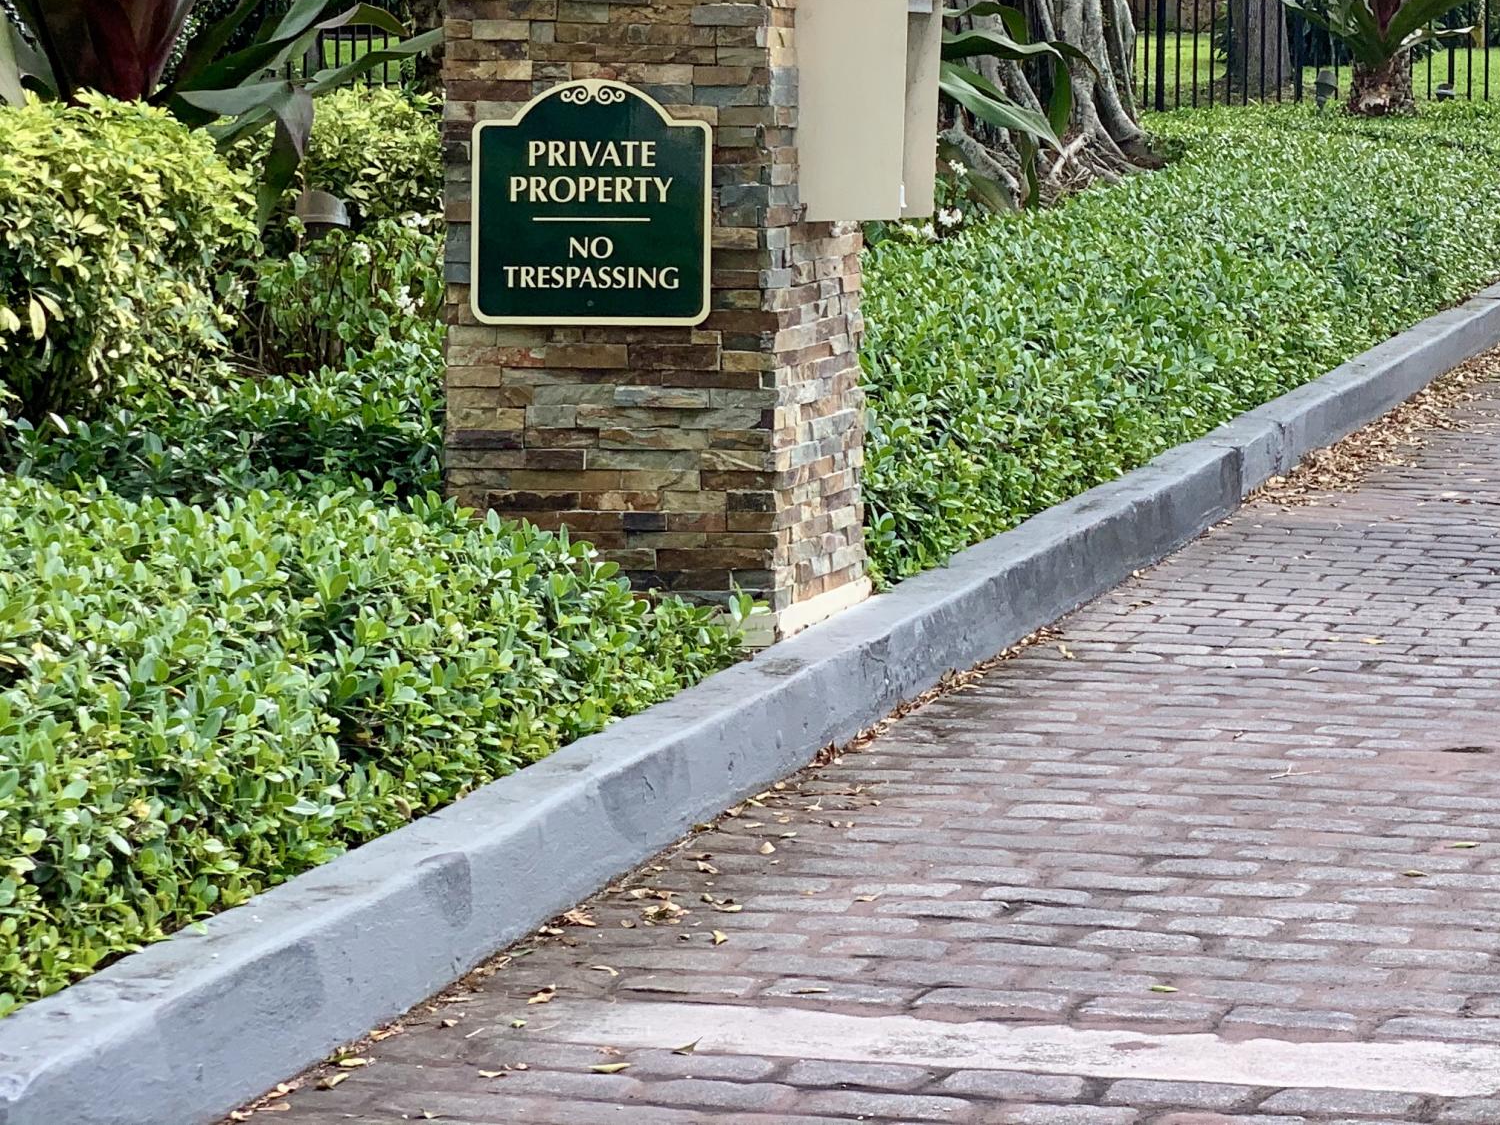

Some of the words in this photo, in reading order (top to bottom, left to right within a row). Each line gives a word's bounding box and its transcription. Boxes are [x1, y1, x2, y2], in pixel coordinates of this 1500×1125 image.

[528, 140, 656, 167] PRIVATE
[510, 176, 673, 203] PROPERTY
[569, 236, 614, 259] NO
[503, 266, 679, 290] TRESPASSING
